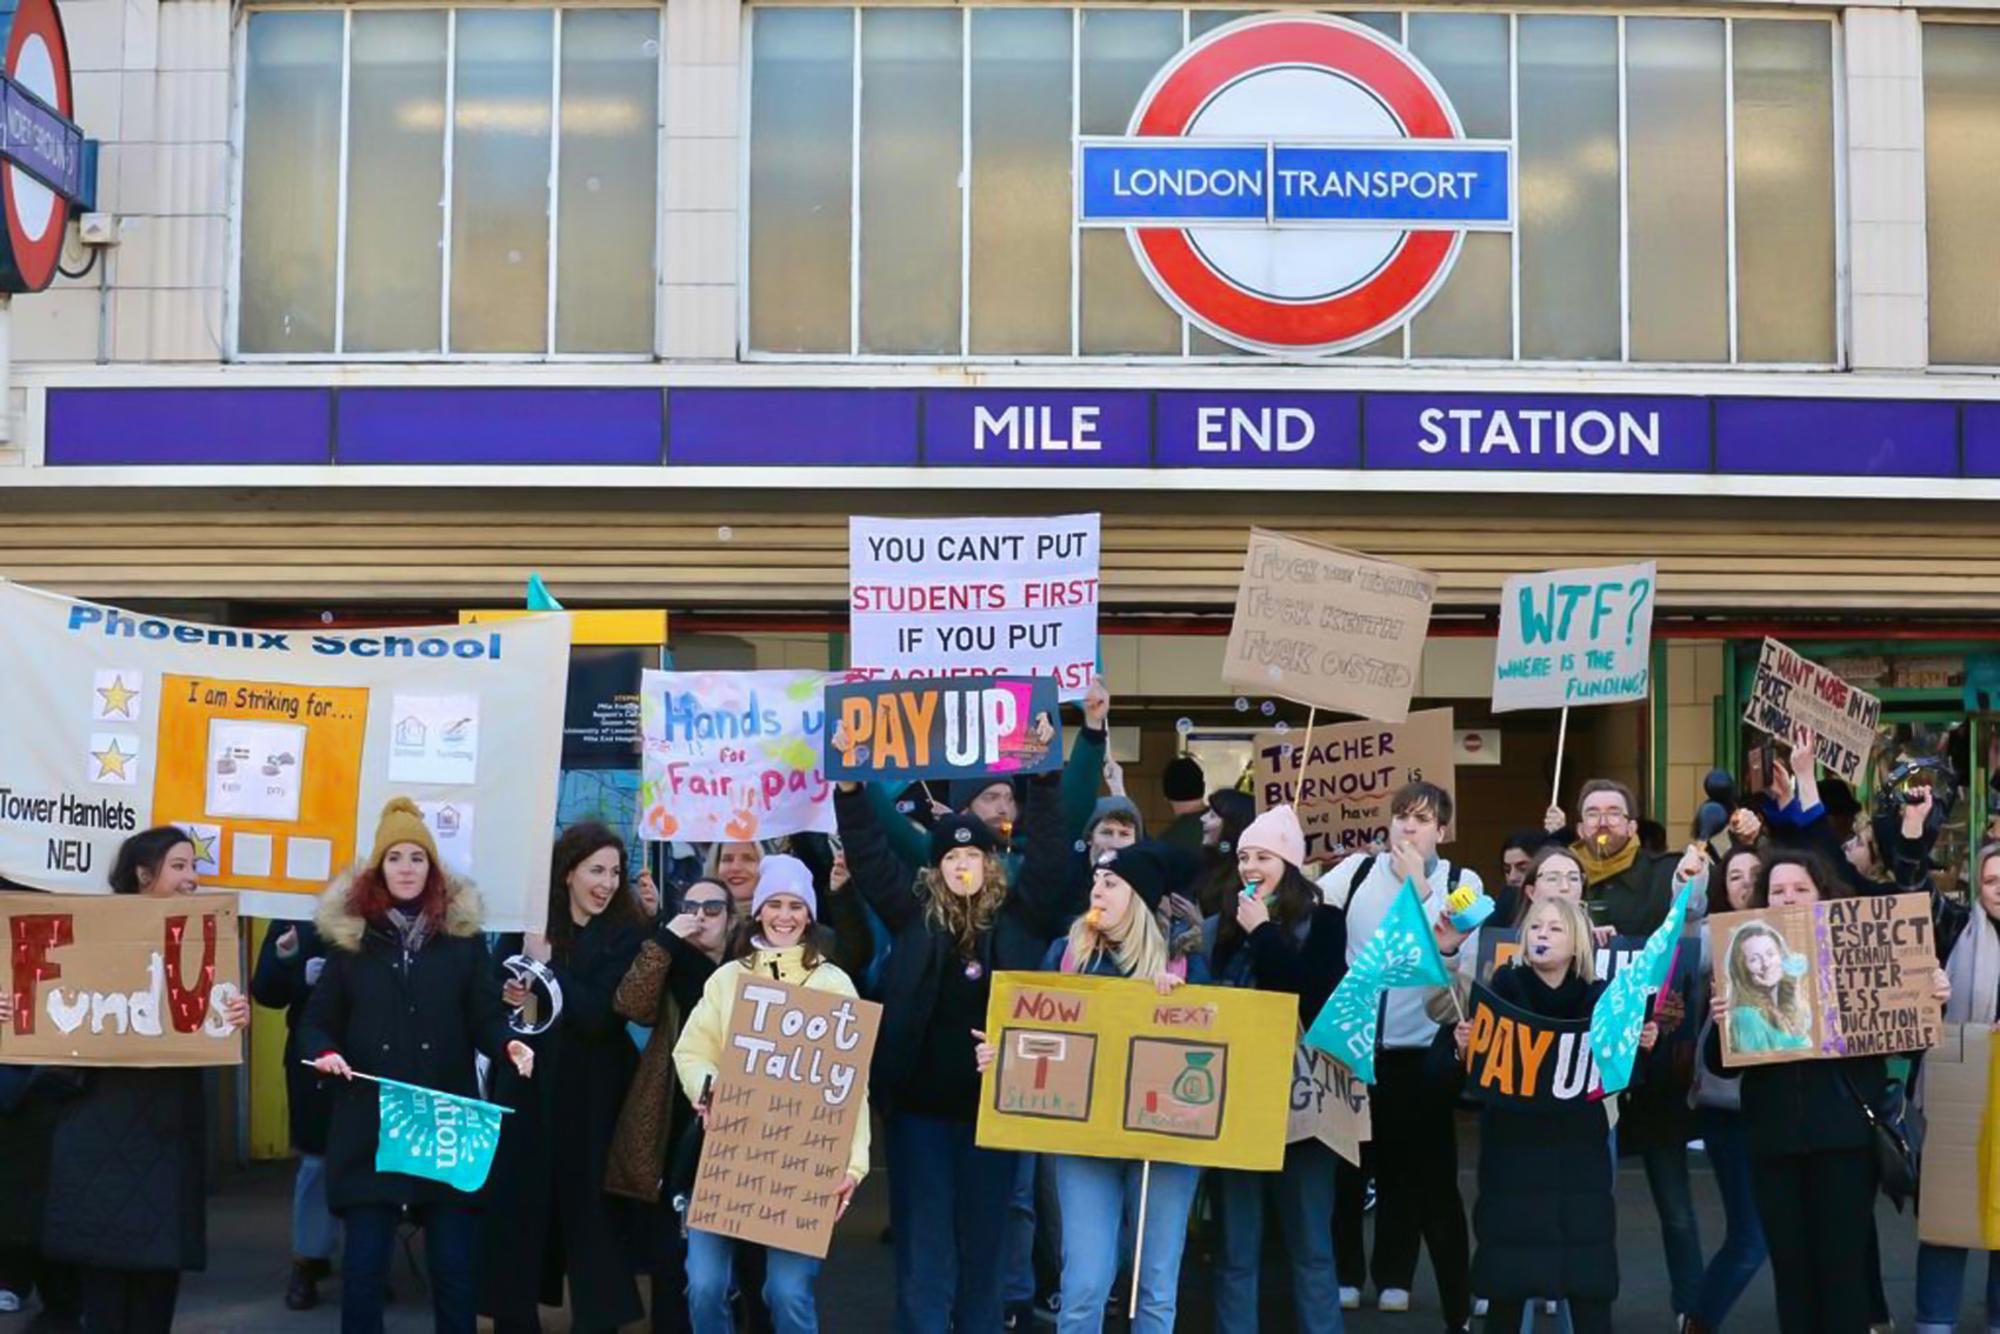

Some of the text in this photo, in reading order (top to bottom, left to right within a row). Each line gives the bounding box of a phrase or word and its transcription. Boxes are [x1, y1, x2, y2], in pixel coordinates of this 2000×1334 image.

[1113, 169, 1478, 199] LONDON TRANSPORT
[972, 405, 1660, 456] MILE END STATION
[868, 532, 1088, 562] YOU CAN'T PUT
[1250, 544, 1321, 583] FUCK
[853, 578, 1098, 611] STUDENTS FIRST
[1247, 586, 1315, 626] FUCK
[1519, 578, 1649, 646] WTF?
[68, 604, 501, 660] Phoenix School
[898, 622, 1063, 654] IF YOU PUT
[1240, 628, 1318, 675] FUCK
[1498, 649, 1616, 680] WHERE IS THE
[1760, 642, 1776, 671] I
[188, 682, 199, 703] I
[205, 688, 228, 708] am
[235, 688, 299, 719] Striking
[1565, 669, 1647, 700] FUNDING?
[664, 688, 782, 743] Hands
[842, 690, 938, 770] PAY
[944, 688, 1018, 767] UP
[1261, 732, 1395, 773] TEACHER
[667, 762, 829, 811] Fair pay
[1264, 766, 1396, 806] BURNOUT
[0, 788, 136, 832] Tower Hamlets
[1307, 803, 1380, 826] we have
[47, 838, 91, 873] NEU
[1304, 826, 1391, 857] TURNO
[1871, 896, 1897, 921] UP
[743, 983, 860, 1052] Toot
[1013, 992, 1082, 1022] NOW
[1152, 1006, 1214, 1026] NEXT
[1466, 1000, 1555, 1097] PAY
[733, 1032, 857, 1105] Tally
